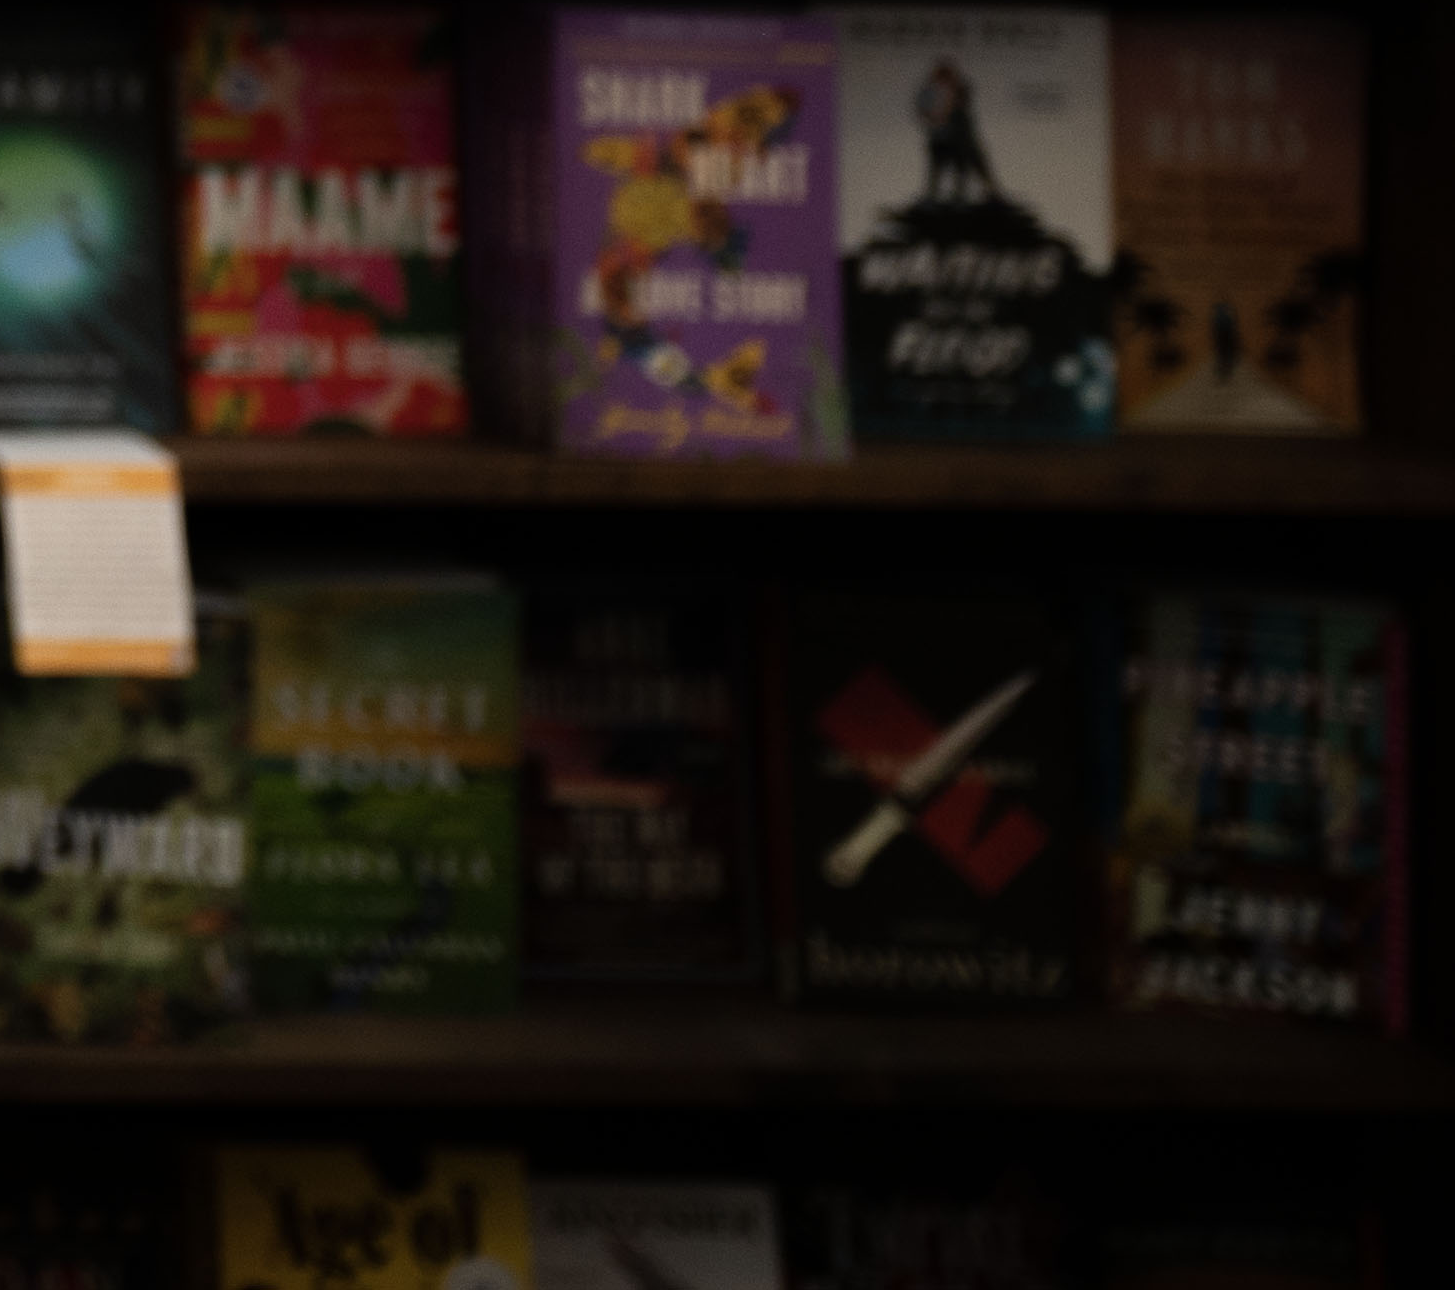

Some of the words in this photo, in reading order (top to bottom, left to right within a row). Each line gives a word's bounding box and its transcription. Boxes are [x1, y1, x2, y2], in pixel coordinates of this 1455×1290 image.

[575, 67, 712, 127] SHARK
[1143, 113, 1310, 166] HANKS
[196, 165, 462, 257] MAAME
[268, 683, 487, 732] SECRET
